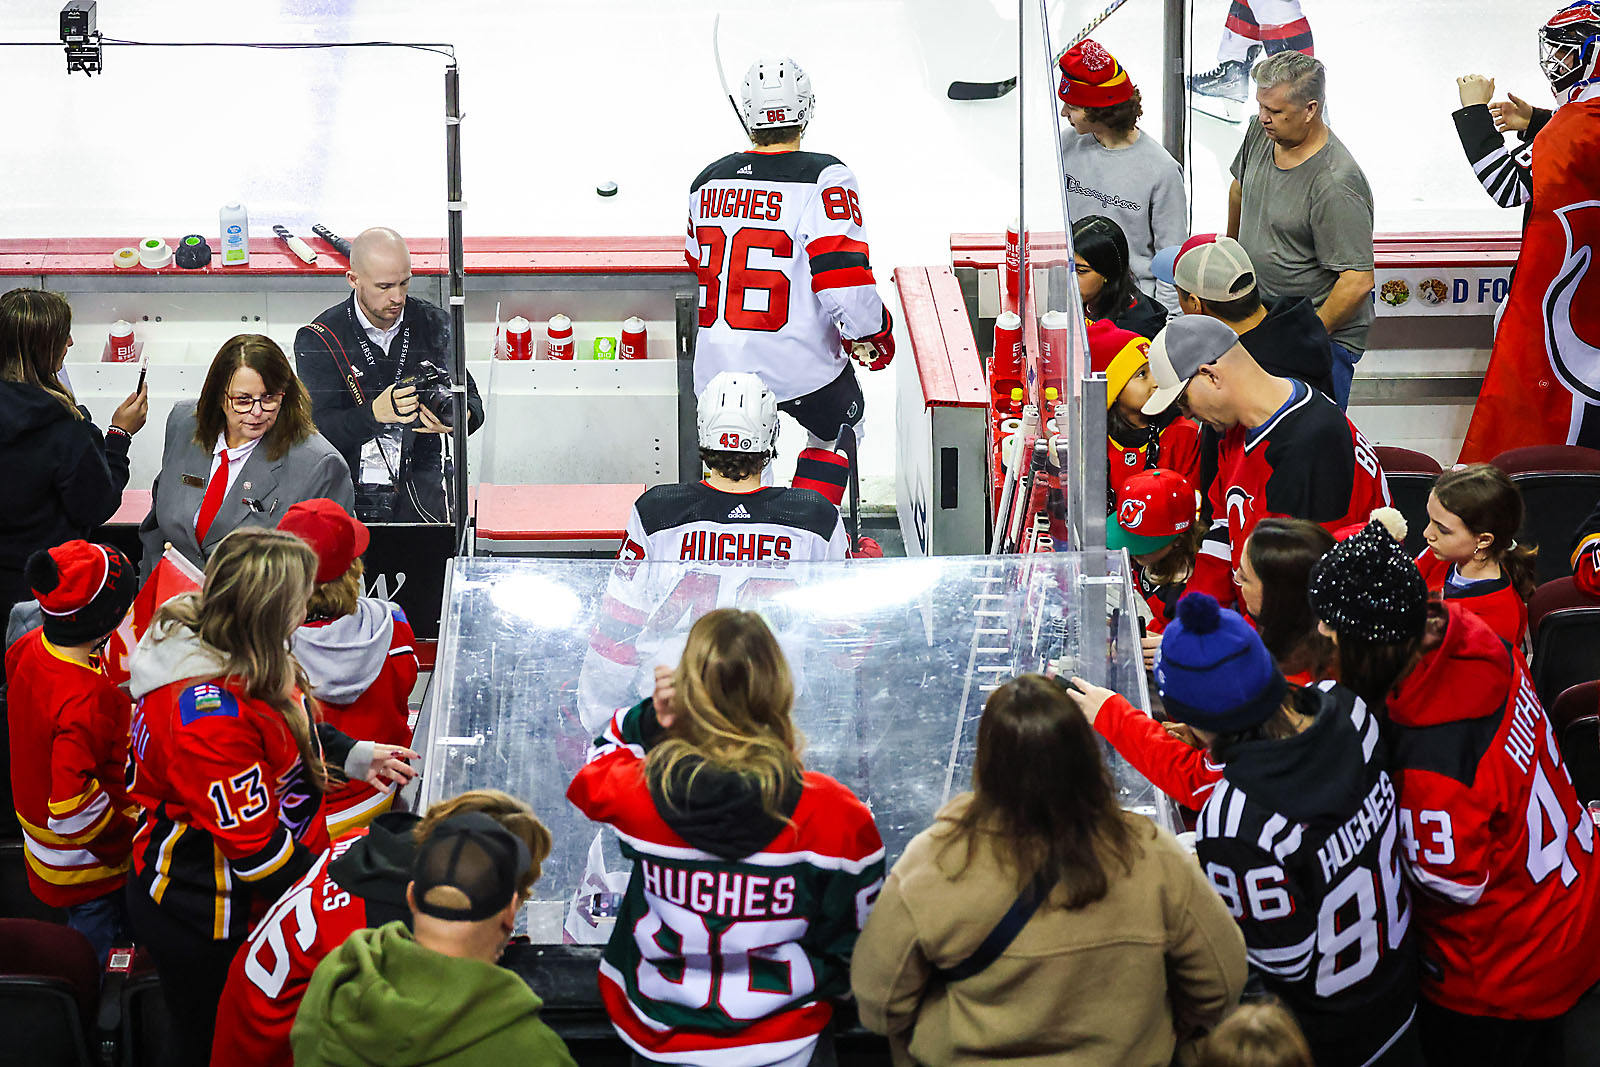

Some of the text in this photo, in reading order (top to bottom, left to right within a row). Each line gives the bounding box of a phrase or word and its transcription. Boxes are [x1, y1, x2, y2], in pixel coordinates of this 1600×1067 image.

[767, 109, 785, 122] 86
[700, 188, 783, 221] HUGHES
[821, 186, 863, 228] 86
[695, 225, 794, 333] 86
[359, 340, 376, 366] JERSEY
[400, 338, 410, 367] JERSEY
[347, 374, 364, 405] Canon
[719, 433, 740, 448] 43
[679, 530, 792, 569] HUGHES
[207, 761, 270, 830] 13
[1317, 770, 1396, 885] HUGHES
[1400, 807, 1456, 865] 43
[642, 859, 796, 917] HUGHES
[1206, 861, 1296, 921] 86
